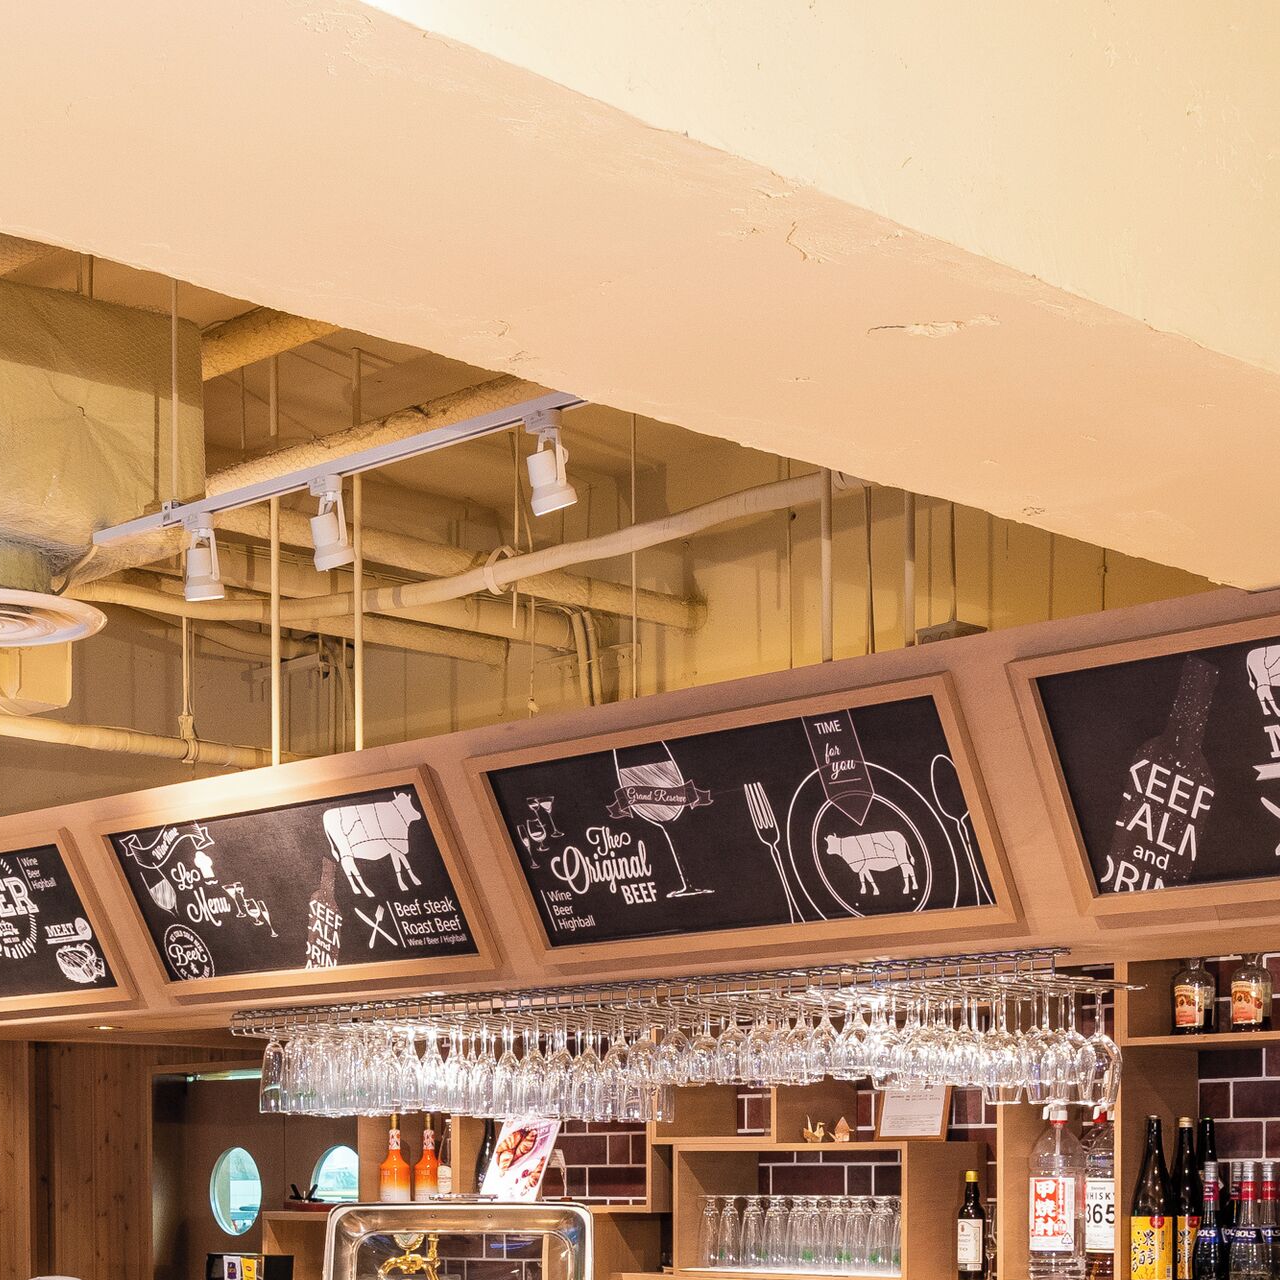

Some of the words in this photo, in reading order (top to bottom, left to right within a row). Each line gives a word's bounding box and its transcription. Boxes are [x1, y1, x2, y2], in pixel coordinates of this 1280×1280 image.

[813, 720, 842, 735] TIME
[825, 743, 841, 764] for
[830, 759, 856, 780] you
[626, 787, 652, 804] Grand
[654, 789, 687, 803] Reserve
[586, 826, 631, 856] The
[21, 857, 38, 867] Wine
[1133, 845, 1170, 870] and
[27, 869, 41, 878] Beer
[170, 862, 201, 891] Le
[550, 840, 652, 895] Original
[547, 889, 572, 902] Wine
[621, 882, 658, 905] BEEF
[187, 887, 231, 927] Menu
[394, 898, 421, 918] Beef
[424, 896, 456, 914] steak
[553, 905, 573, 916] Beer
[45, 922, 76, 938] MEAT
[401, 920, 434, 936] Roast
[437, 915, 462, 932] Beef
[558, 915, 596, 932] Highball
[407, 937, 423, 947] Wine
[427, 936, 440, 945] Beer
[168, 943, 208, 966] Beer
[1086, 1192, 1115, 1200] HISK
[1235, 1229, 1257, 1238] BOLS
